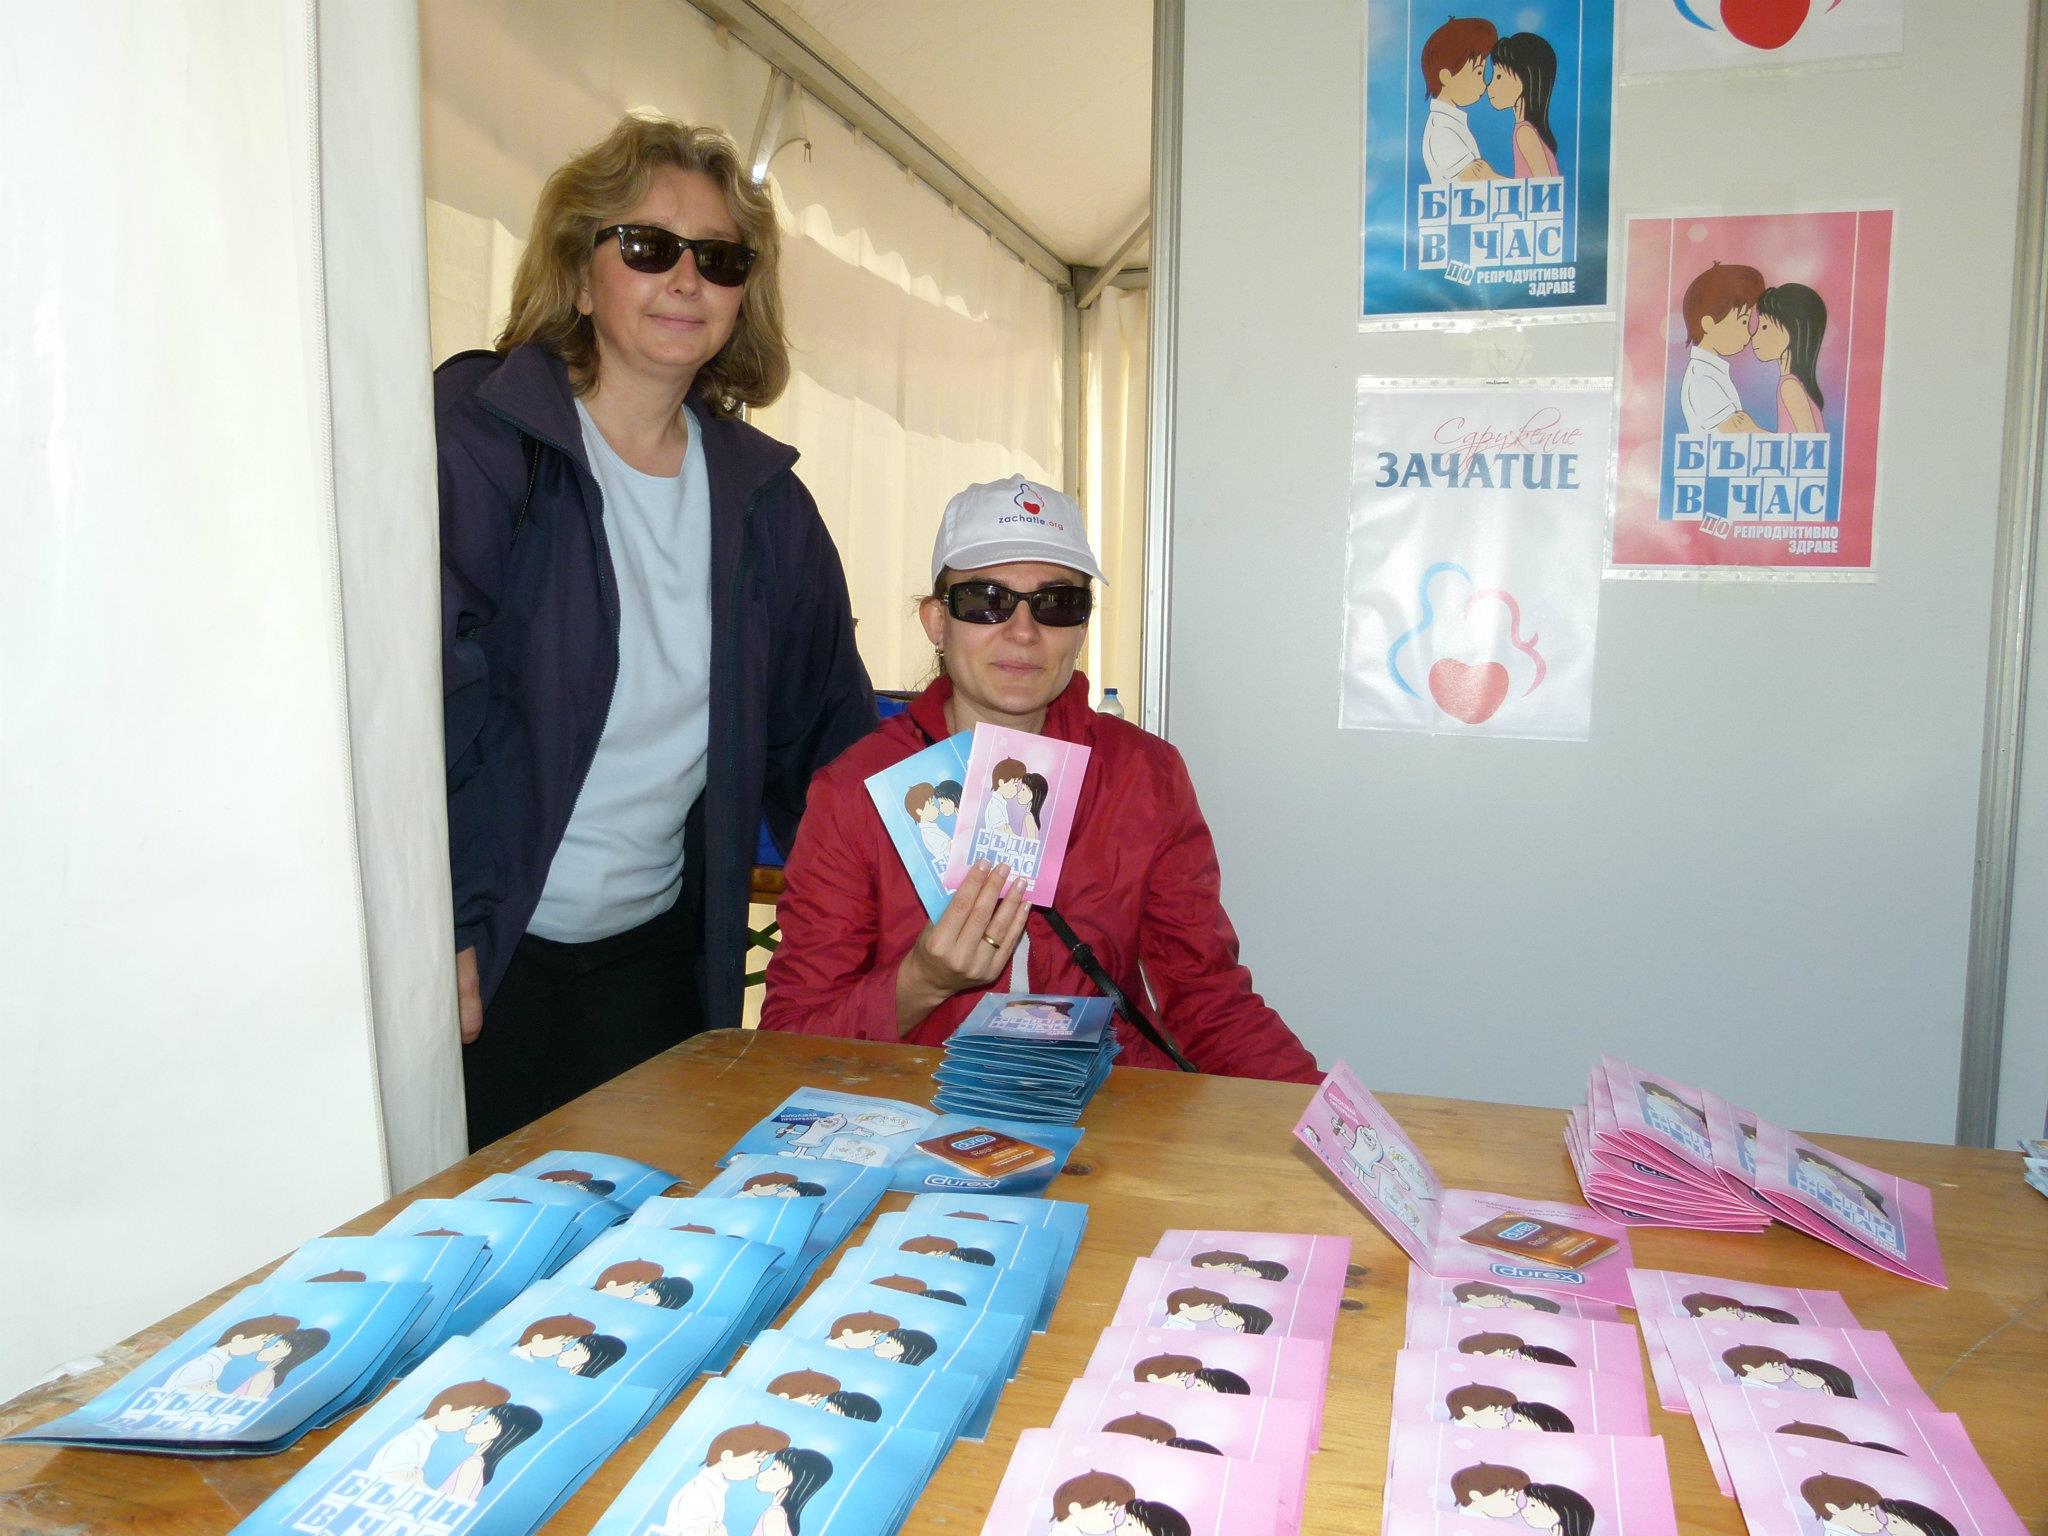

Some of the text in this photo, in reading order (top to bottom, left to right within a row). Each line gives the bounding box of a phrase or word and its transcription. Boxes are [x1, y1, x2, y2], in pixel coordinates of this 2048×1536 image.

[1420, 182, 1563, 221] БЪДИ
[1420, 226, 1562, 264] В ЧАС
[1447, 260, 1576, 285] ПО РЕПРОДУКТИВНО
[1528, 281, 1577, 296] ЗДРАВЕ
[1676, 440, 1827, 475] БЪДИ
[1375, 452, 1581, 489] ЗАЧАТИЕ
[1675, 484, 1825, 515] В ЧАС
[998, 514, 1064, 531] zachatie.org
[1701, 513, 1839, 540] ПО РЕПРОДУКТИВНО
[1788, 540, 1839, 554] ЗДРАВЕ
[977, 831, 1038, 856] БЪДИ
[930, 1176, 993, 1188] durex
[1506, 1222, 1538, 1239] durex
[1499, 1266, 1574, 1284] durex
[130, 1391, 264, 1417] БЪДИ
[328, 1474, 472, 1527] БЪДИ
[299, 1502, 338, 1527] В
